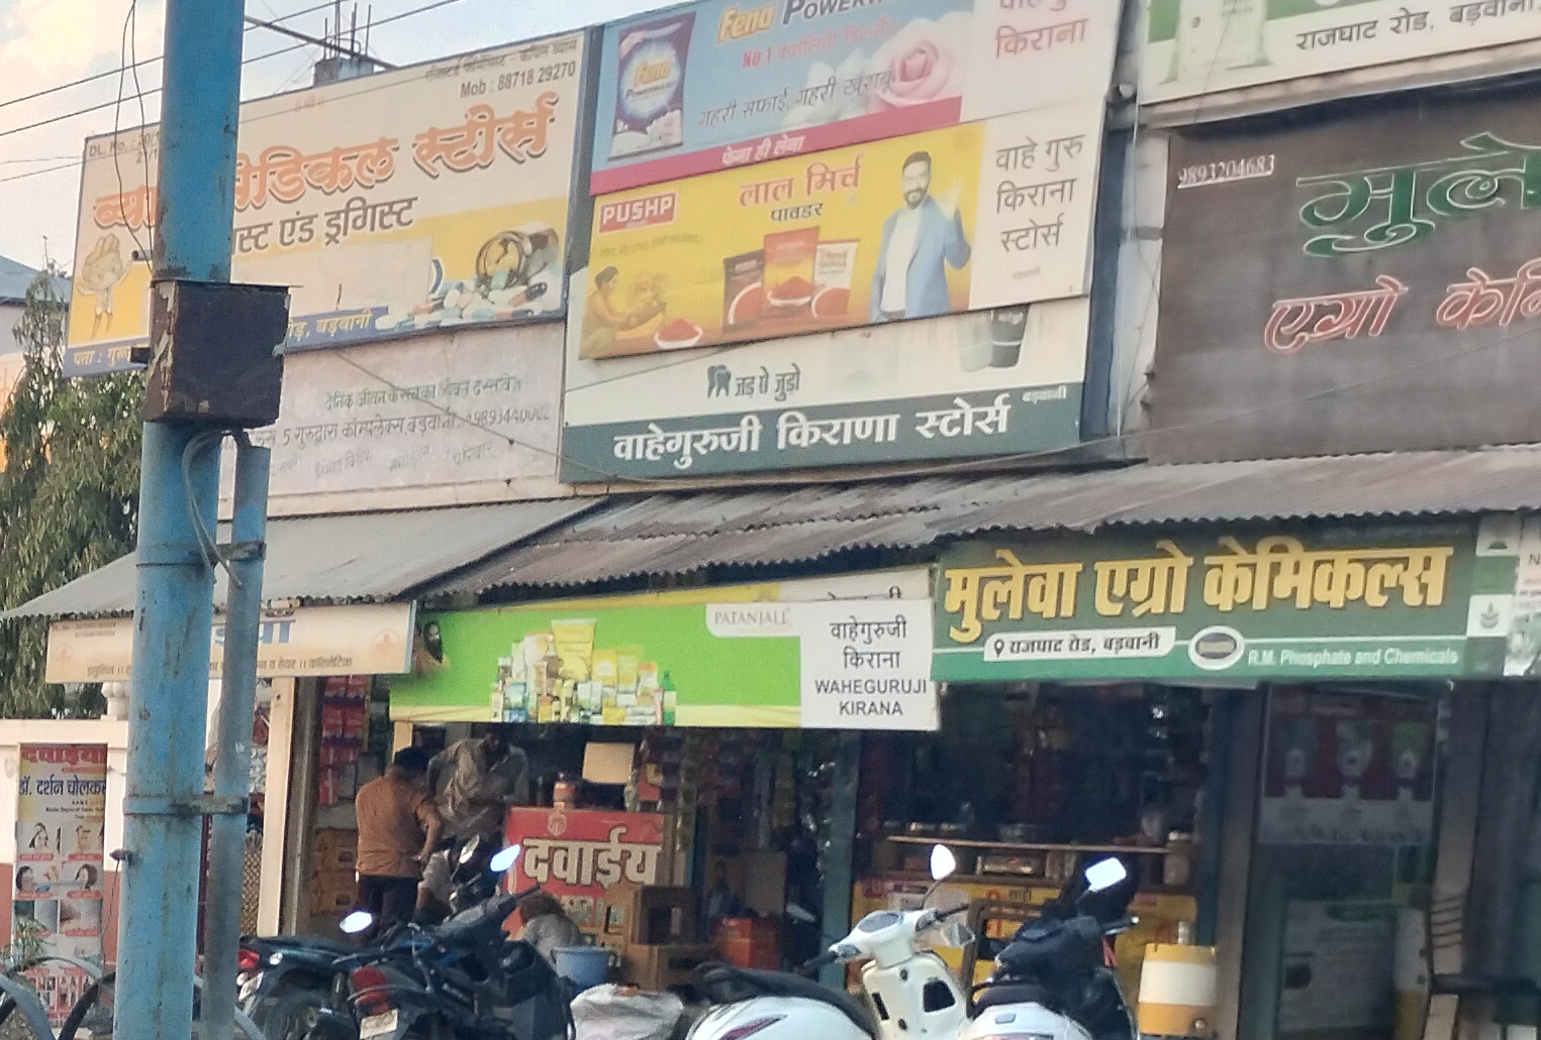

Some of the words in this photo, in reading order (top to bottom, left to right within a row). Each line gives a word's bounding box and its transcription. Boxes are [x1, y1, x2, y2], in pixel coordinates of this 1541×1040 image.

[996, 18, 1090, 58] किराना
[1297, 20, 1378, 50] राजघाट
[1391, 9, 1434, 34] रोड,
[461, 79, 486, 98] Mob
[497, 68, 534, 91] 88718
[538, 60, 576, 84] 29270
[699, 98, 737, 127] गहरी
[796, 76, 836, 107] गहरी
[413, 90, 559, 178] स्टोर्स
[755, 135, 772, 161] ही
[996, 136, 1038, 171] वाहे
[1045, 134, 1085, 172] गुरु
[1177, 153, 1276, 182] 9893204683
[739, 177, 796, 207] लाल
[806, 155, 863, 197] मिर्च
[996, 178, 1077, 214] किराना
[279, 209, 318, 246] एंड
[324, 196, 419, 246] ड्रगिस्ट
[602, 197, 673, 225] PUSHP
[771, 203, 823, 223] पावडर
[1000, 213, 1065, 252] स्टोर्स
[1265, 274, 1409, 352] एग्रो
[735, 374, 756, 399] जड़
[774, 362, 801, 402] जुड़ो
[613, 414, 762, 470] वाहेगुरुजी
[776, 411, 902, 451] किराणा
[914, 392, 1012, 440] स्टोर्स
[944, 548, 1083, 643] मुलेवा
[1094, 540, 1194, 618] एग्रो
[1203, 535, 1455, 612] केमिकल्स
[714, 609, 789, 626] PATANJALI
[829, 614, 908, 645] वाहेगुरुजी
[843, 646, 901, 670] किराना
[1009, 639, 1063, 655] राजघाट
[1248, 650, 1276, 666] R.M.
[1280, 650, 1351, 669] Phosphate
[1355, 649, 1381, 665] and
[1384, 648, 1460, 665] Chemicals
[815, 679, 927, 694] WAHEGURUJI
[839, 701, 904, 716] KIRANA
[19, 774, 33, 796] डॉ.
[36, 773, 64, 797] दर्शन
